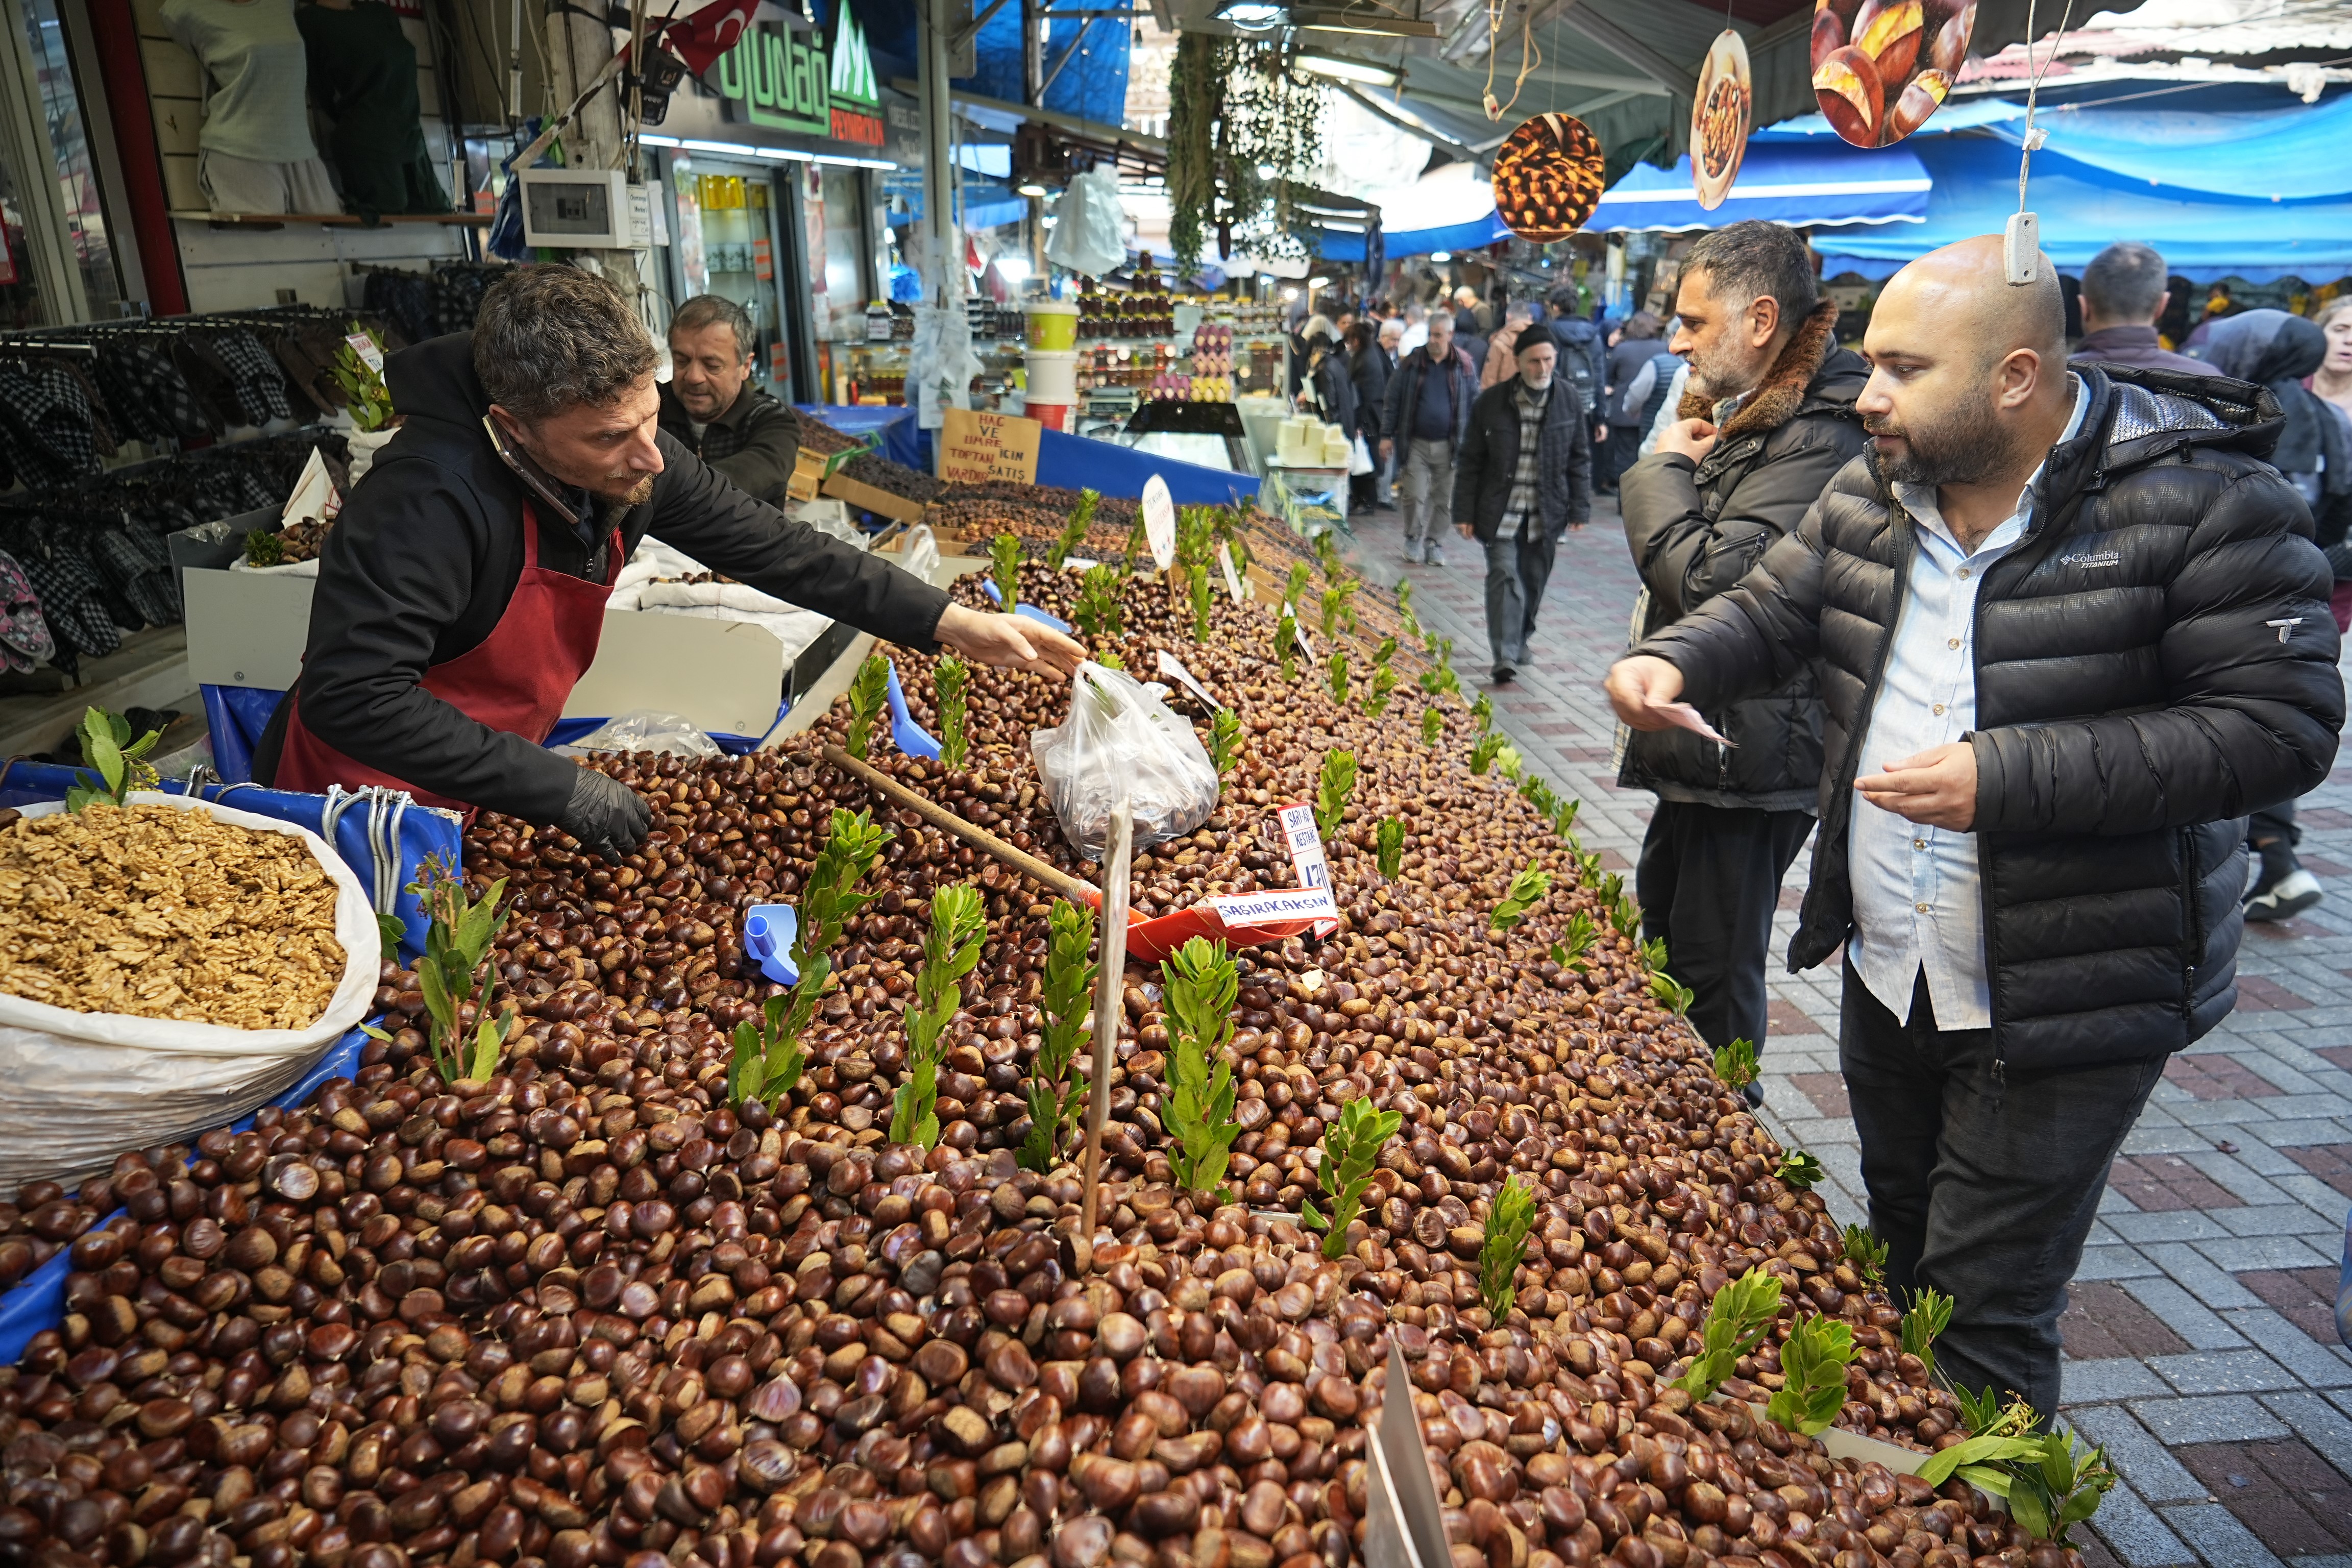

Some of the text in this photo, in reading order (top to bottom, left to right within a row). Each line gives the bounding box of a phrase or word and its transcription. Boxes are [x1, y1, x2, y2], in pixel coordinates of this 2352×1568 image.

[979, 414, 1004, 427] HAC
[979, 425, 999, 438] VE
[949, 448, 995, 464] TOPTAN
[946, 466, 989, 481] VARDIR
[2071, 551, 2119, 562] Columbia
[2080, 559, 2118, 569] TITANIUM
[1294, 828, 1316, 848] KESTANE
